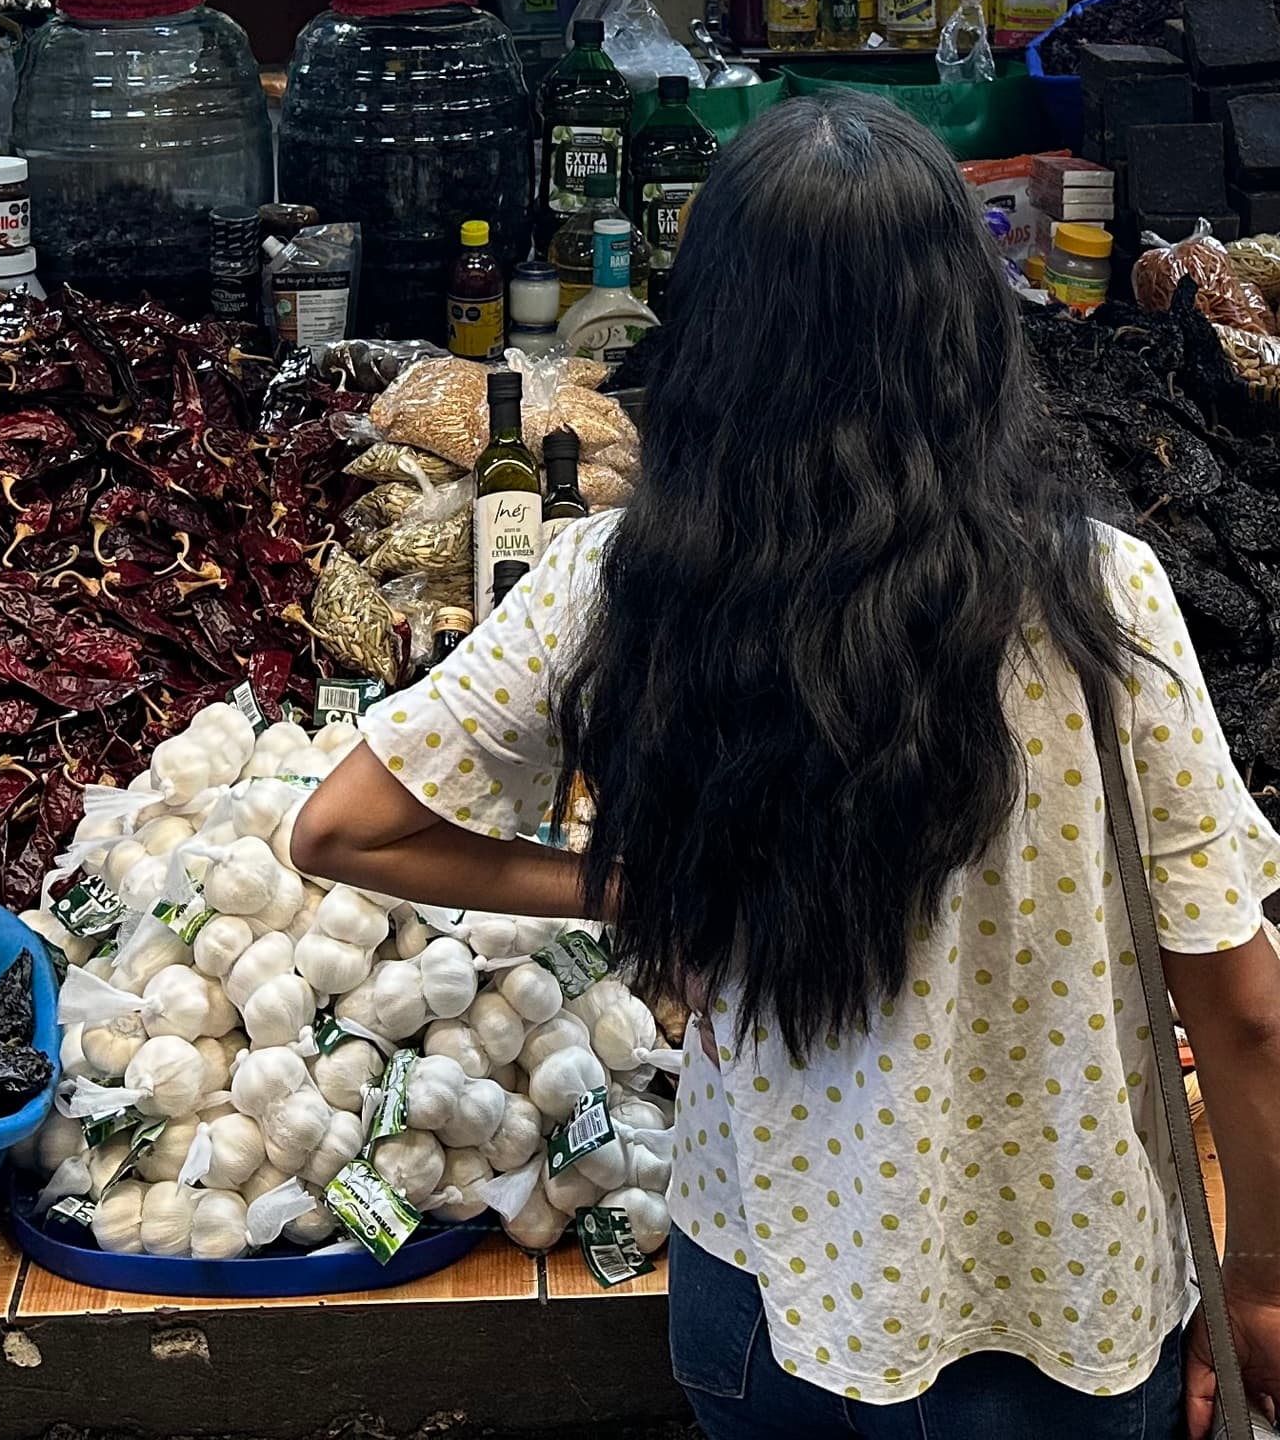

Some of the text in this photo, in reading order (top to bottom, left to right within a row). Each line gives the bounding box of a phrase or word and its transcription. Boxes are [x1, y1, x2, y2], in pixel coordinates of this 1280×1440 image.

[565, 152, 608, 165] EXTRA
[565, 164, 608, 178] VIRGIN
[658, 209, 681, 221] EXT
[658, 221, 680, 234] VIR
[494, 499, 531, 524] Inés
[495, 534, 531, 550] OLIVA
